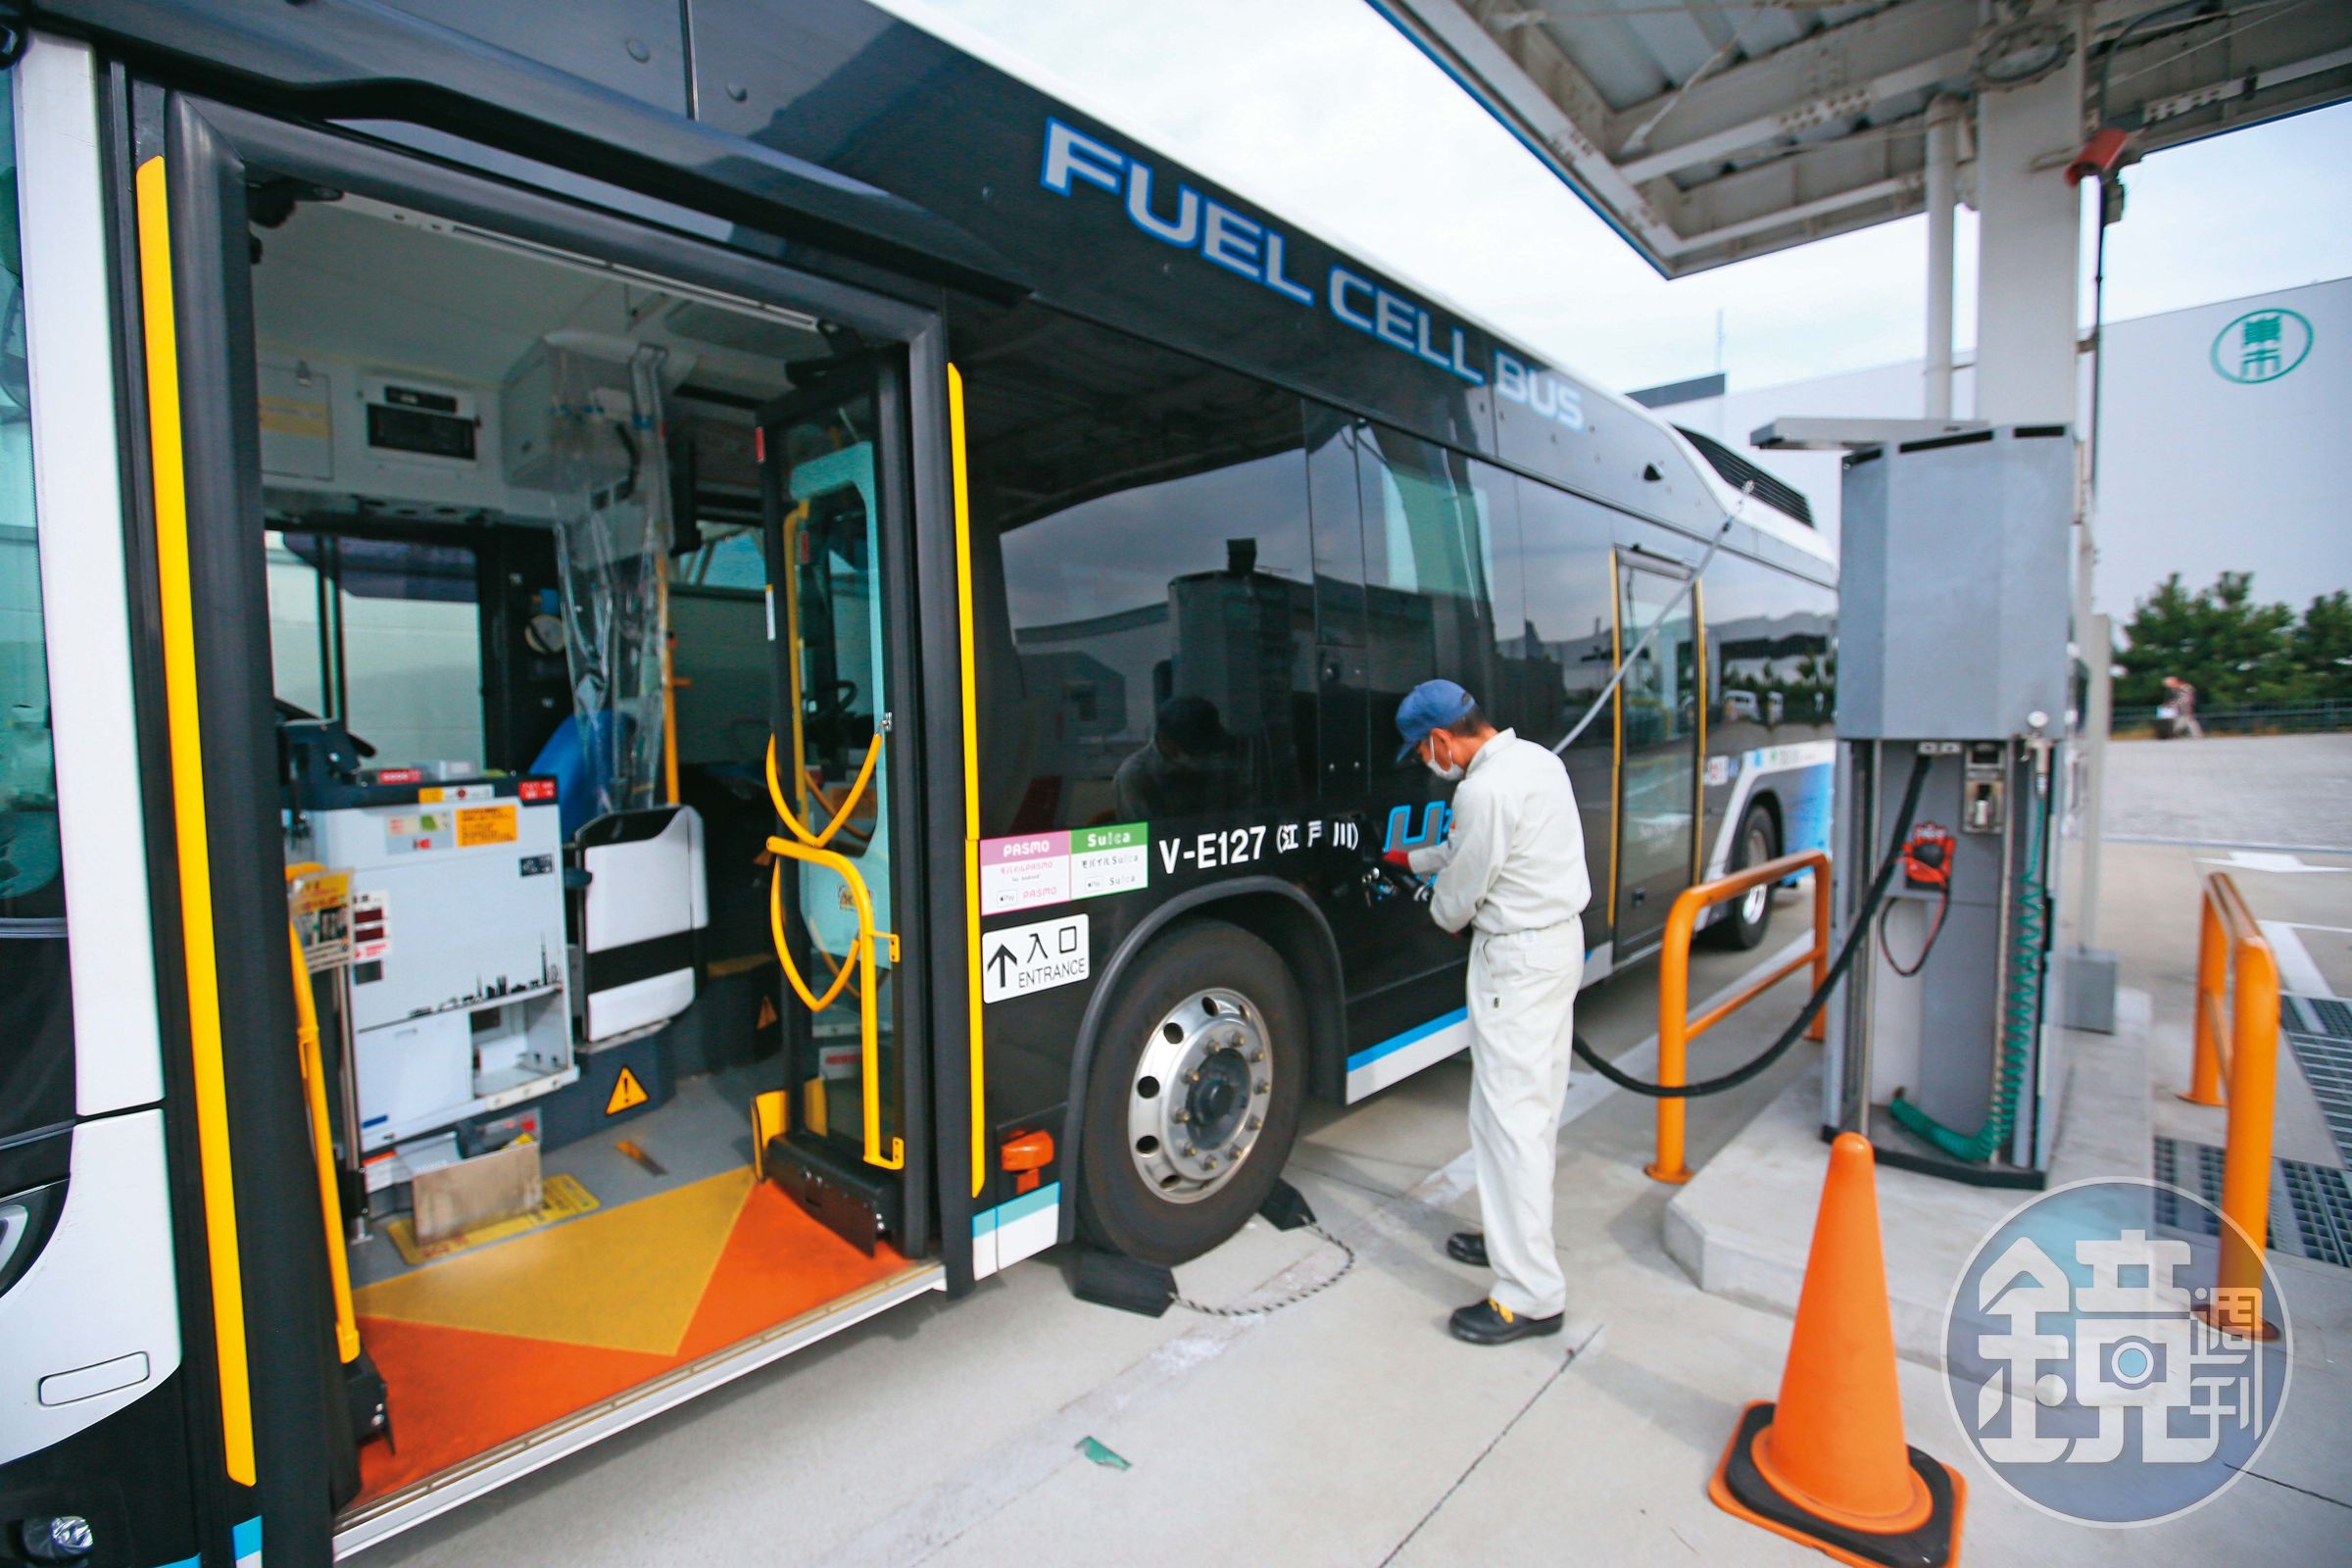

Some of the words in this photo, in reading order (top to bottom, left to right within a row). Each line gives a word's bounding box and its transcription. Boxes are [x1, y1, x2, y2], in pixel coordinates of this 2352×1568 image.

[1040, 115, 1313, 307] FUEL
[1328, 265, 1486, 385] CELL
[1494, 348, 1585, 431] BUS
[1004, 840, 1051, 858] PASMO
[1087, 831, 1131, 848] Suica
[1158, 825, 1266, 874] V-E127
[1022, 886, 1057, 900] PASMO
[1027, 925, 1077, 963] 入口
[1019, 957, 1085, 989] ENTRANCE
